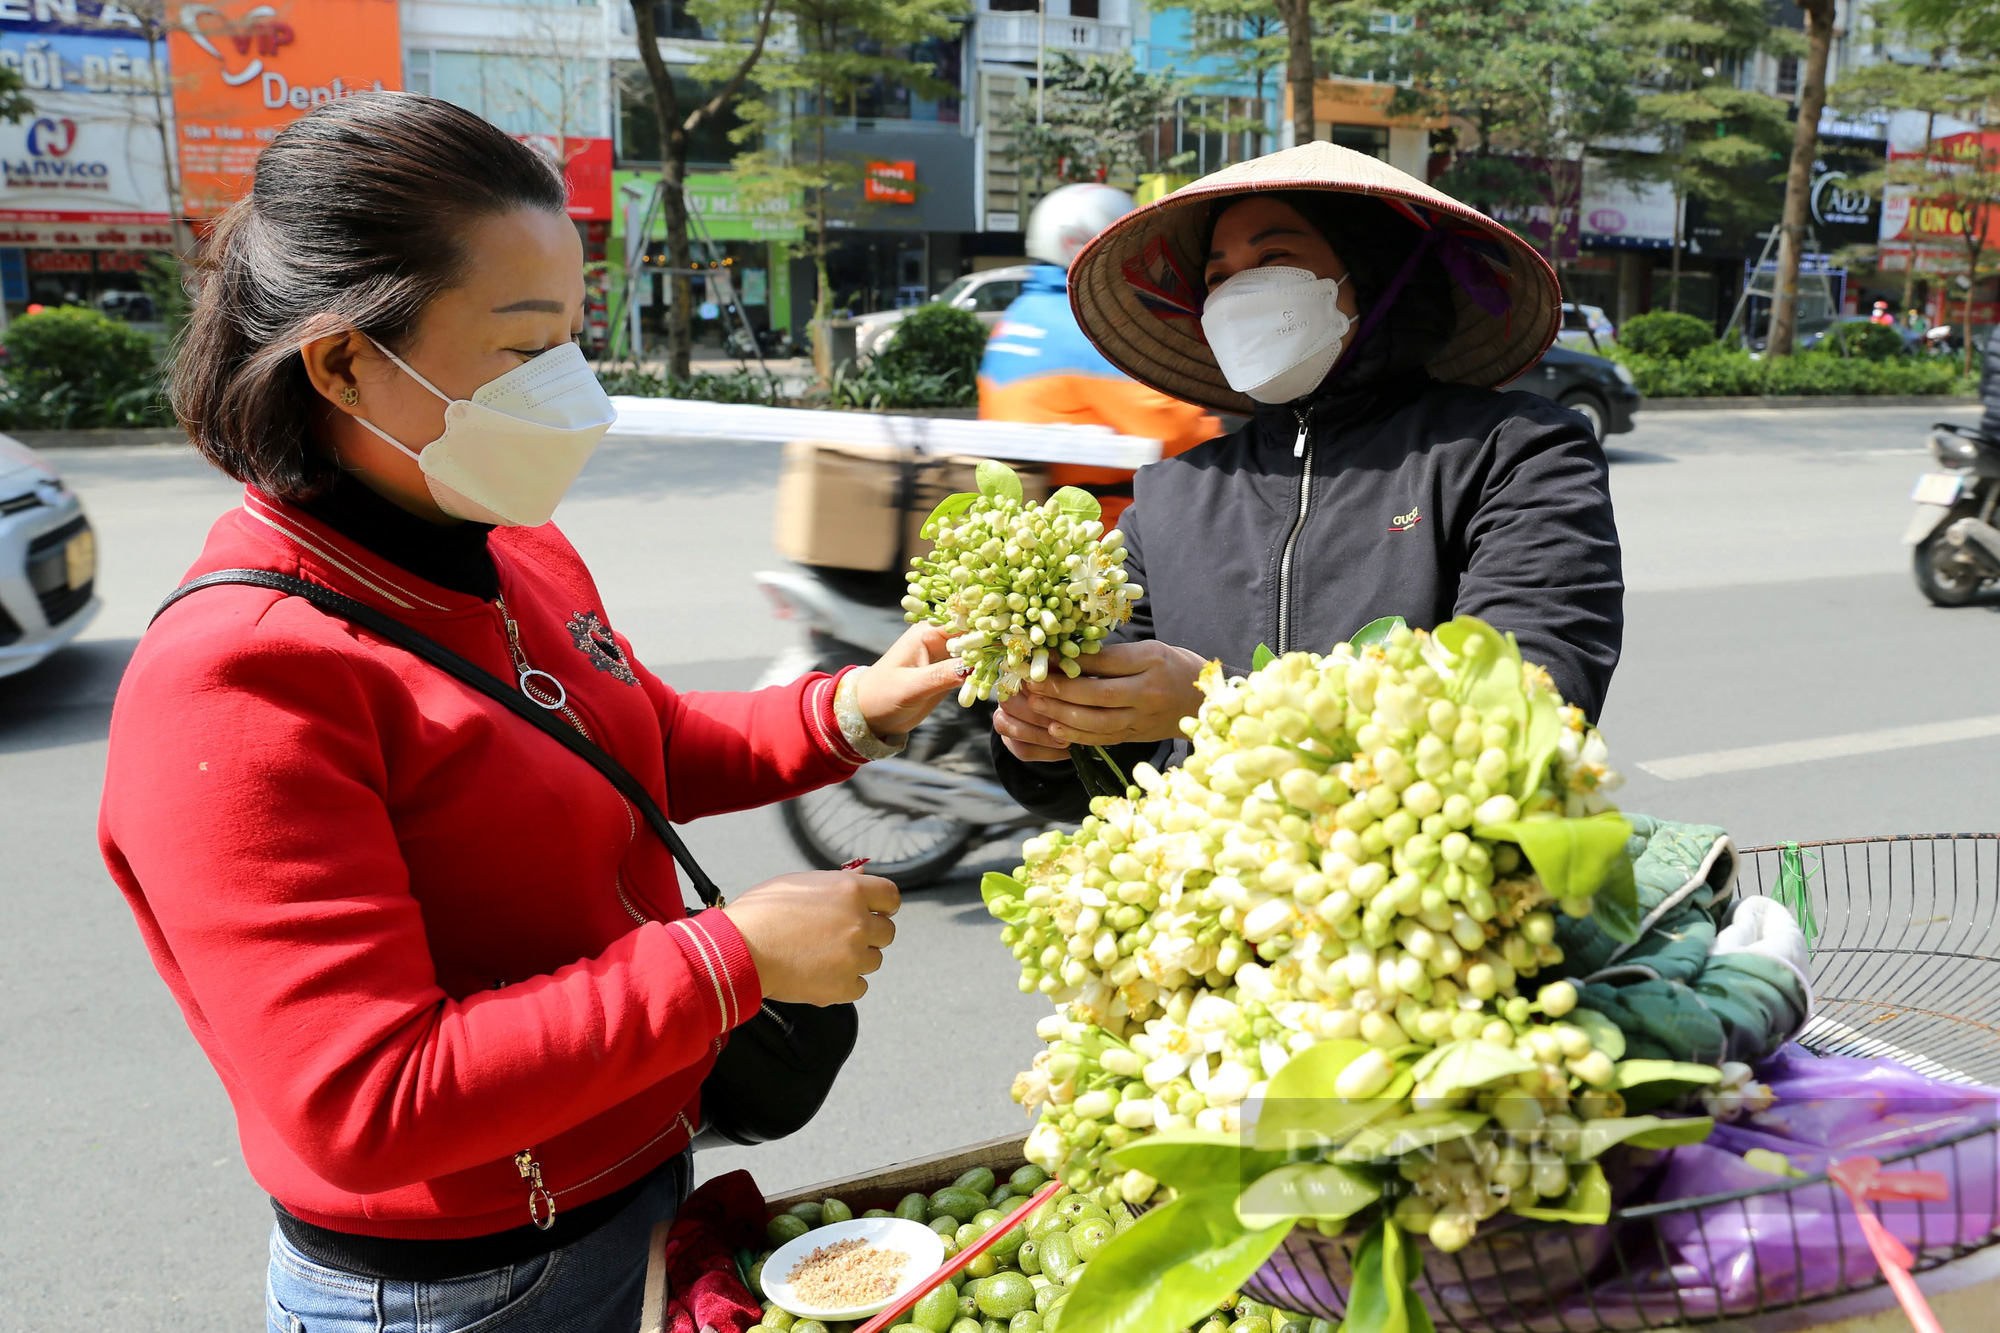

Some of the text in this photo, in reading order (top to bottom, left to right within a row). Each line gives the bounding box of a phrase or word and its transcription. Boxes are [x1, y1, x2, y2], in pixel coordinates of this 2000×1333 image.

[233, 22, 294, 56] VIP
[262, 72, 383, 109] Dent
[1827, 188, 1870, 213] ADJ
